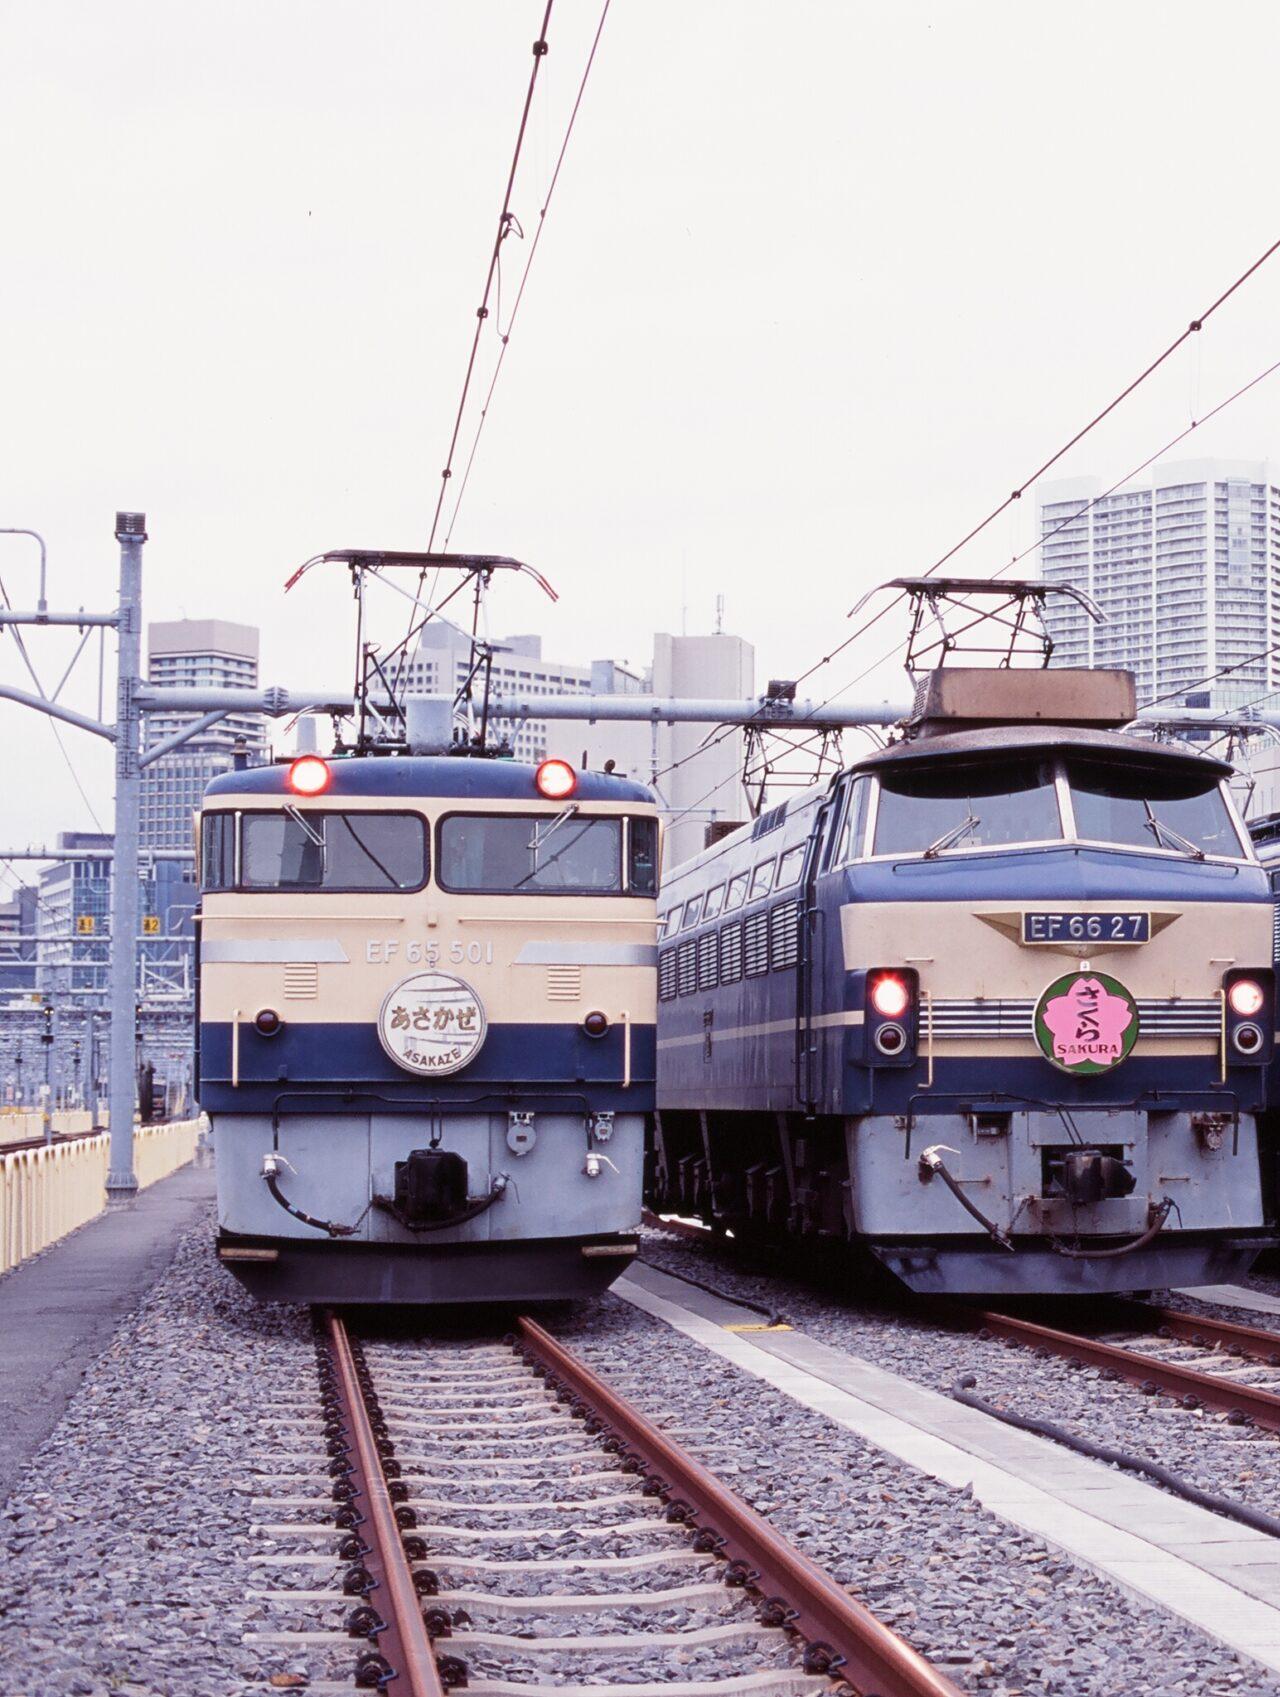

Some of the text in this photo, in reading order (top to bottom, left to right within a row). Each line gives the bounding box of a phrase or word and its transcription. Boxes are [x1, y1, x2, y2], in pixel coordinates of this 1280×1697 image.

[1030, 916, 1142, 939] EF 66 27
[366, 940, 494, 965] EF 65 501
[390, 1006, 477, 1031] あさかぜ
[1075, 986, 1100, 1042] さくら
[403, 1048, 462, 1067] ASAKAZE
[1057, 1043, 1119, 1055] SAKURA
